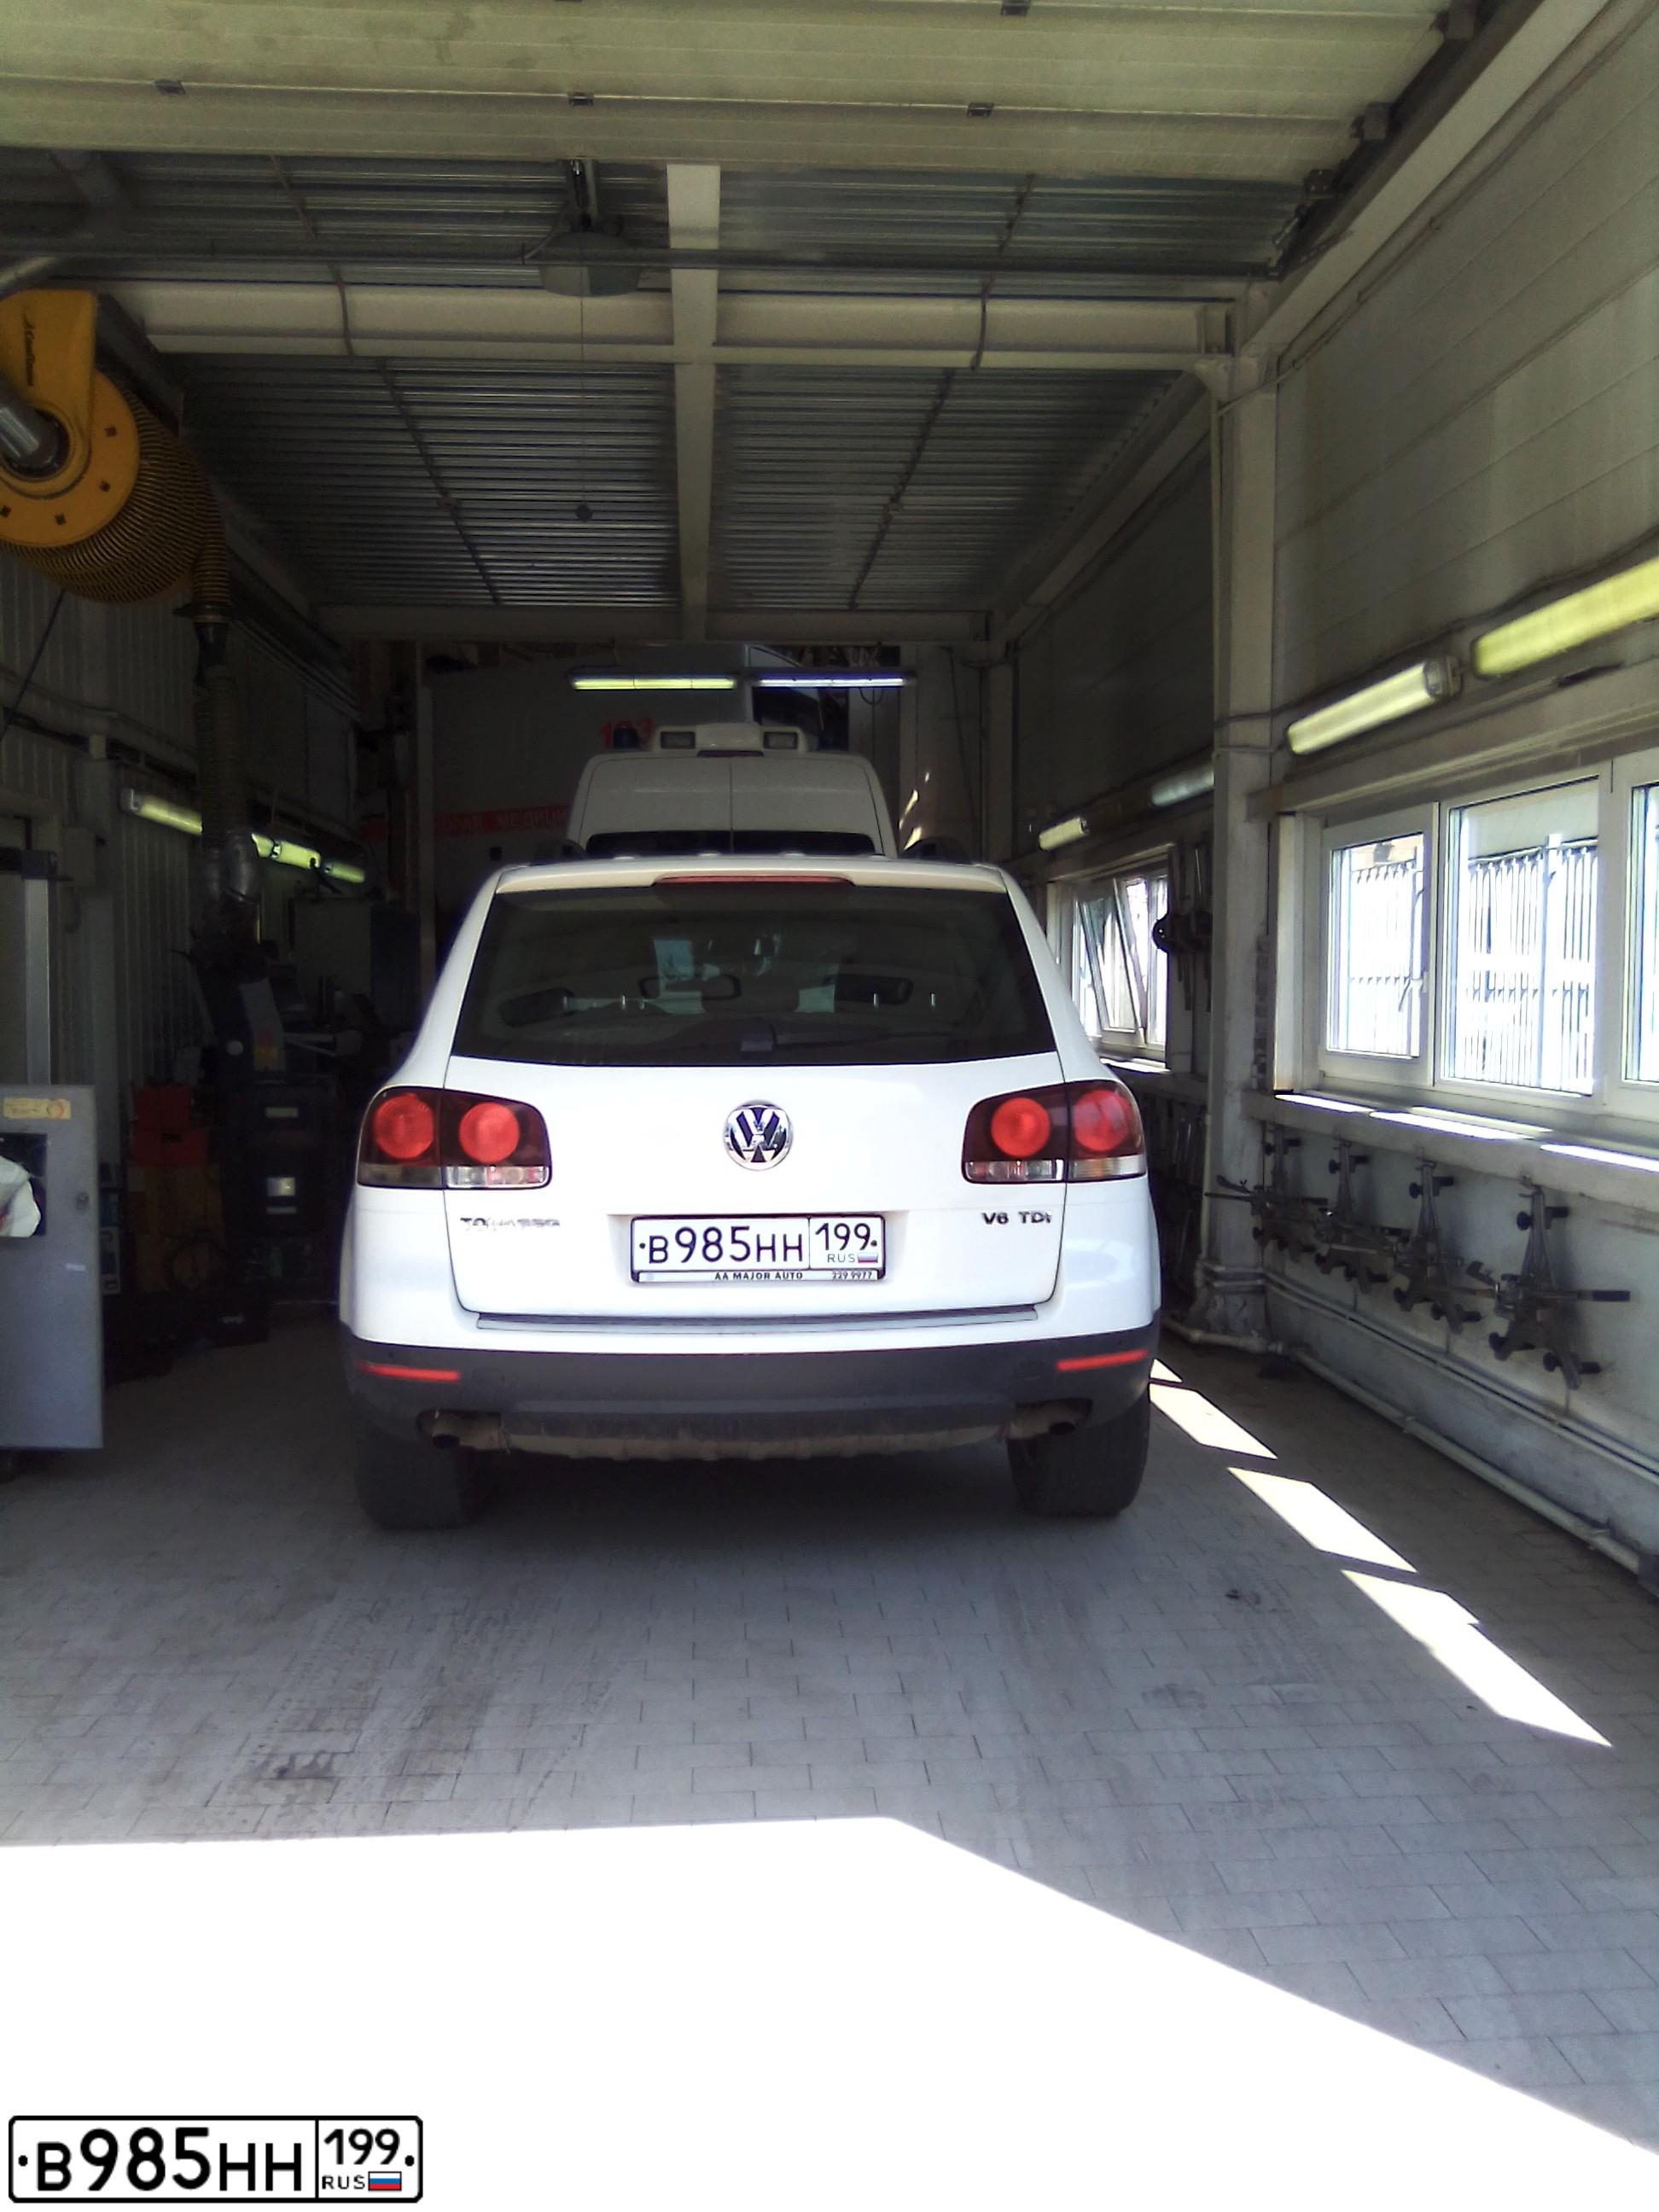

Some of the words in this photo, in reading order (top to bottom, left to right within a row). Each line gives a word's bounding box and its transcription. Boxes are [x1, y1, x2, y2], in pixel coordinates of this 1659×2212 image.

[816, 1223, 871, 1251] 199
[827, 1254, 856, 1263] RUS
[715, 1272, 729, 1280] AA
[733, 1272, 770, 1280] MAJOR
[775, 1272, 803, 1280] AUTO
